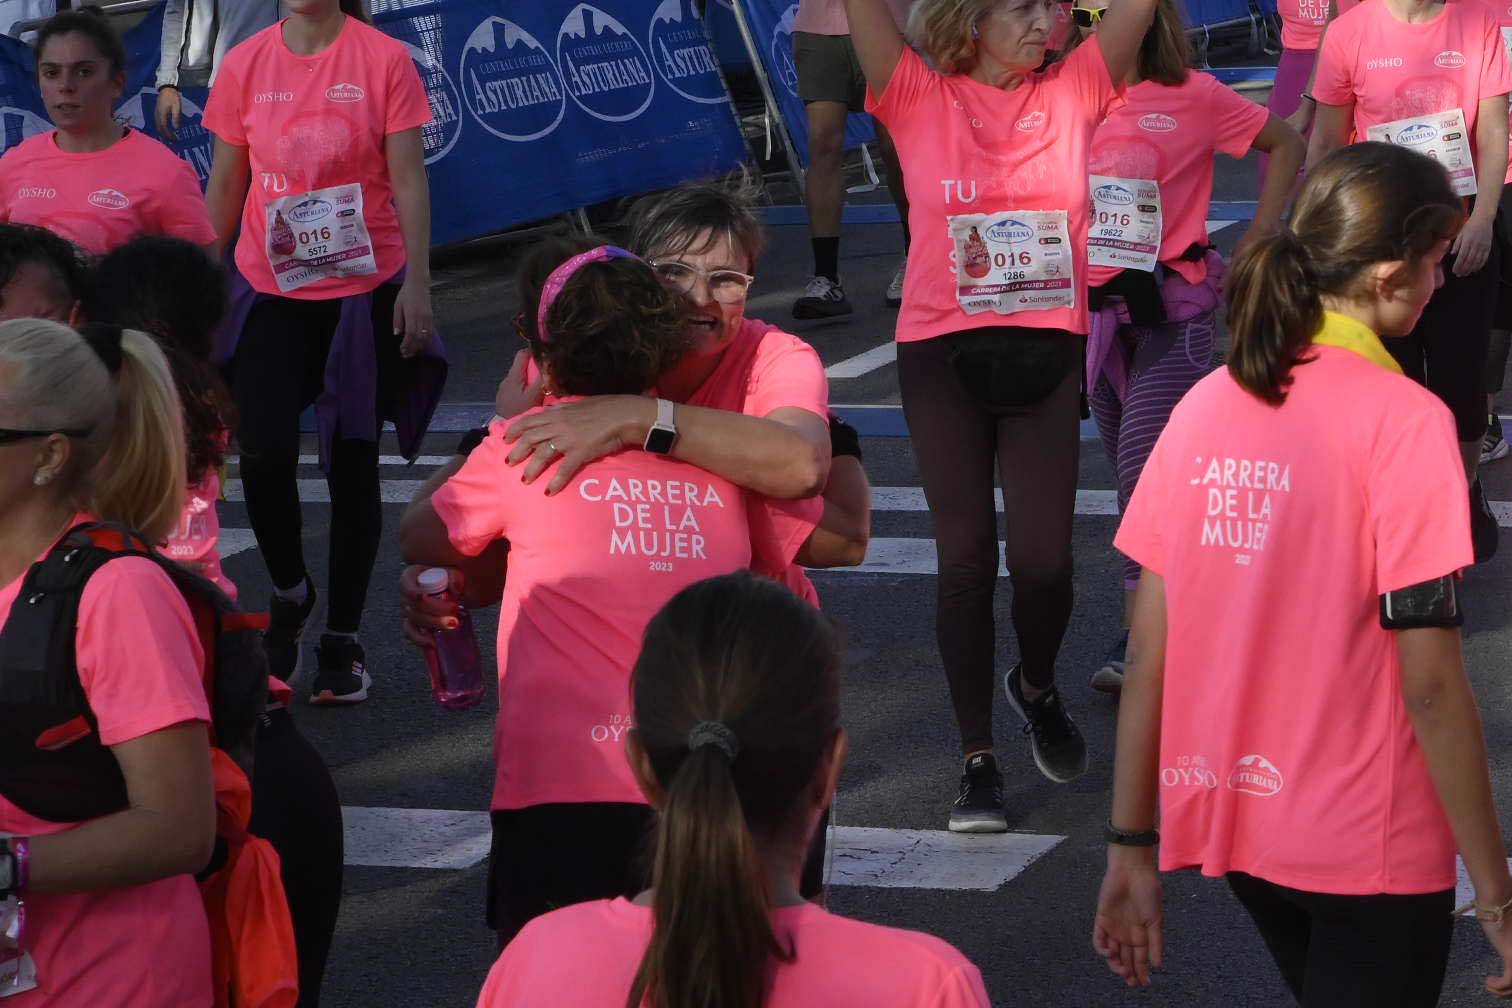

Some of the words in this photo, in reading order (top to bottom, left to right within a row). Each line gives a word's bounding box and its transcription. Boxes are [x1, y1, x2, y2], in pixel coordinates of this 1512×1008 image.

[1366, 57, 1404, 71] OYSHO
[565, 52, 651, 97] ASTURIANA
[254, 92, 294, 104] OYSHO
[470, 68, 562, 117] ASTURIANA
[261, 172, 288, 193] TU
[941, 179, 977, 204] TU
[291, 204, 331, 220] ASTURIANA
[1099, 211, 1131, 226] 016
[299, 226, 332, 246] 016
[990, 225, 1031, 239] ASTURIANA
[1037, 224, 1059, 232] SUMA
[307, 244, 329, 257] 5572
[994, 251, 1032, 268] 016
[1003, 271, 1025, 281] 1286
[1028, 294, 1065, 303] Santander
[579, 478, 724, 508] CARRERA
[1207, 488, 1238, 517] DE
[1248, 491, 1272, 521] LA
[613, 502, 652, 529] DE
[663, 506, 700, 533] LA
[609, 530, 706, 560] MUJER
[648, 561, 673, 573] 2023
